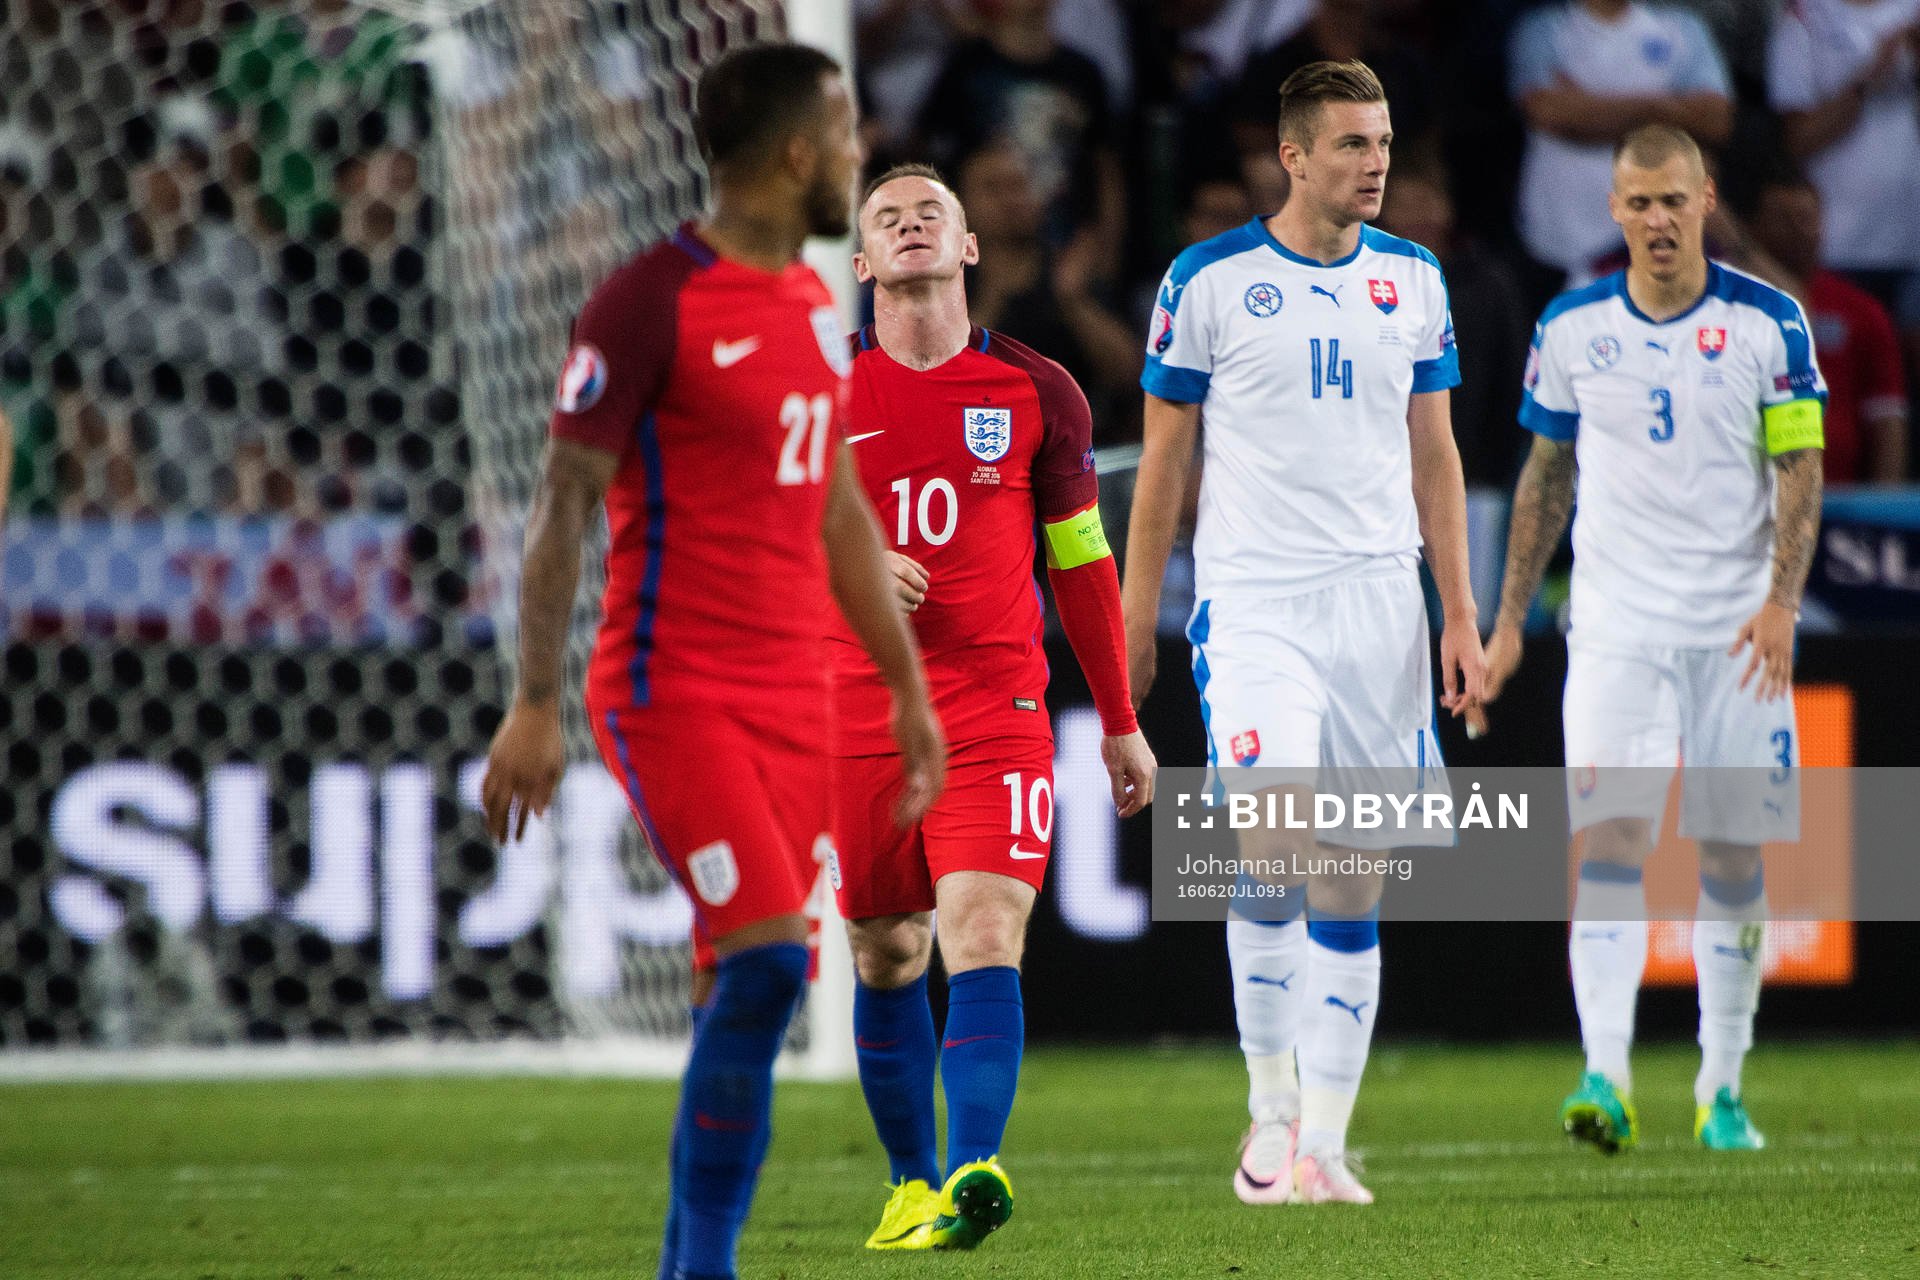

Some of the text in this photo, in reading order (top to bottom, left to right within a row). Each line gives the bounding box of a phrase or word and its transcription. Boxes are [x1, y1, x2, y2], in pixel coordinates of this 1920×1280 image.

[1310, 338, 1354, 399] 14
[775, 392, 833, 486] 21
[1649, 388, 1674, 443] 3
[891, 477, 958, 546] 10
[1078, 526, 1091, 536] NO
[1769, 727, 1793, 787] 3
[1003, 772, 1053, 843] 10
